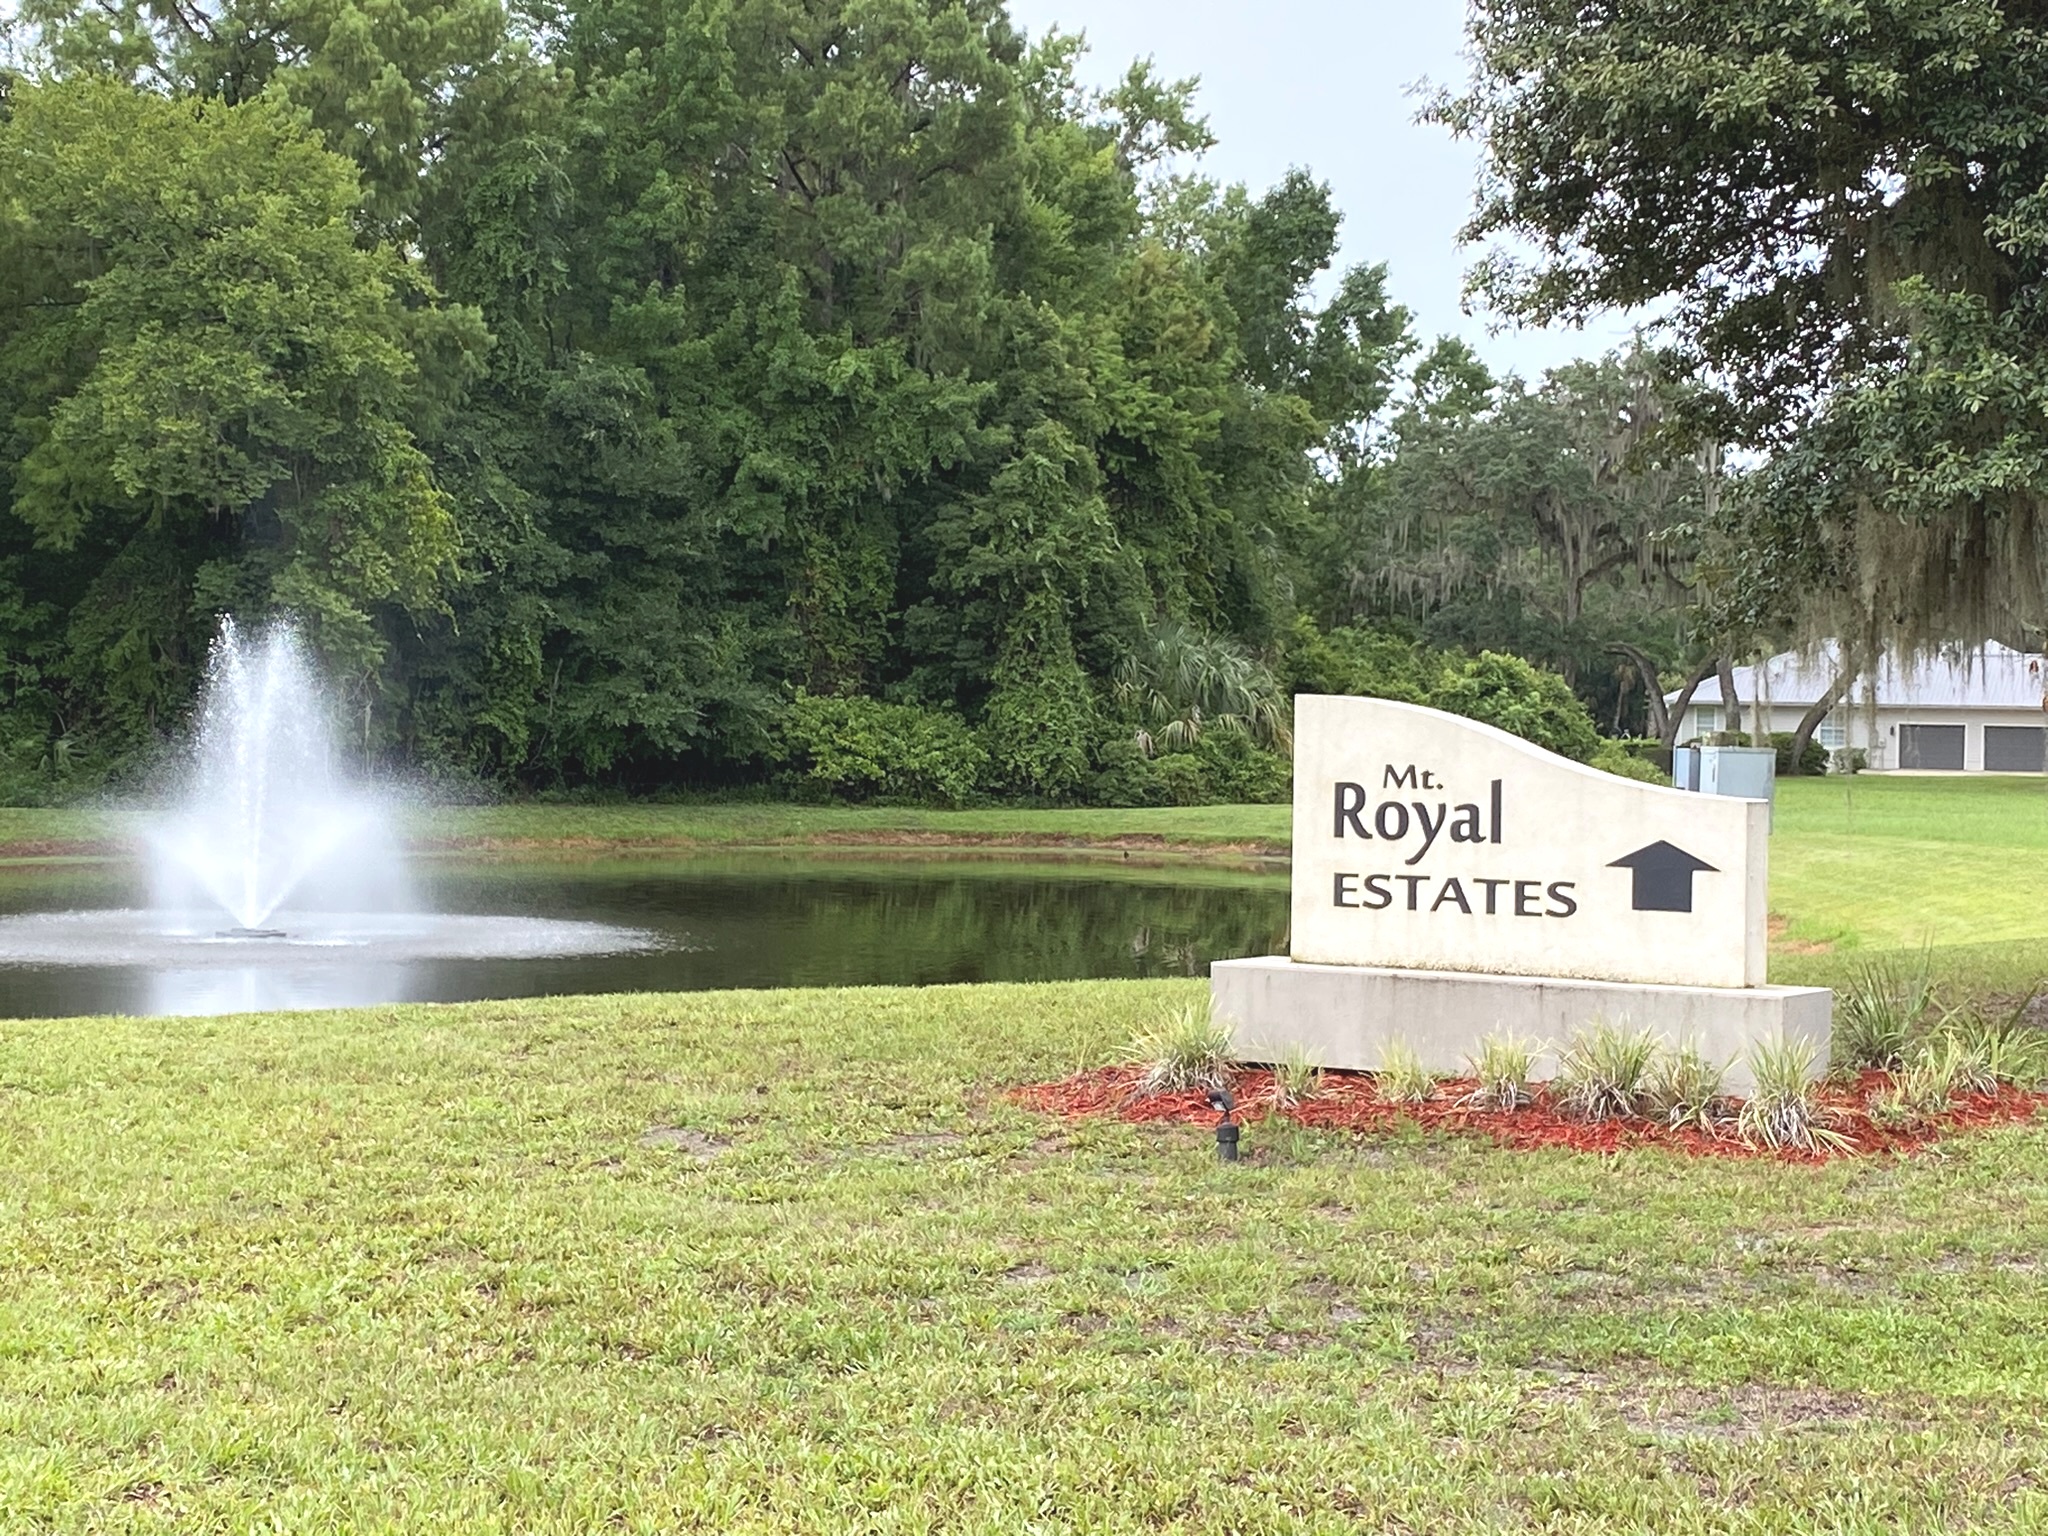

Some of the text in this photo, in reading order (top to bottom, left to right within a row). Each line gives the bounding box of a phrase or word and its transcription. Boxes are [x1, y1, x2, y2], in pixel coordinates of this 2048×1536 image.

[1383, 763, 1444, 790] Mt.
[1333, 779, 1502, 866] Royal
[1333, 872, 1577, 918] ESTATES
